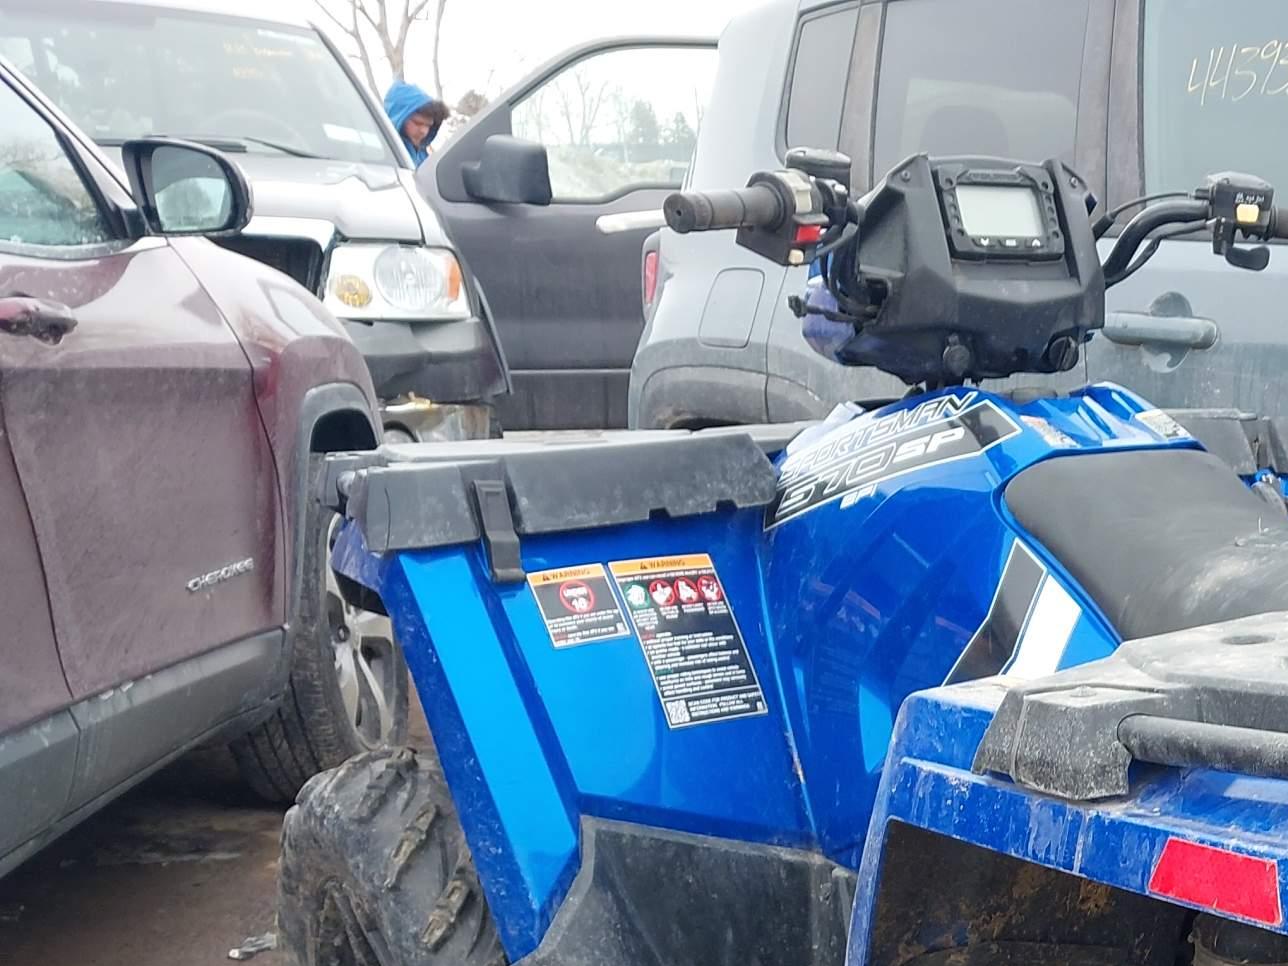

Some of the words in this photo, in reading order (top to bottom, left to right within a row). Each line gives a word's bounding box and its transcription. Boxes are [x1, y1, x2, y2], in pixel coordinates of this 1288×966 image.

[775, 442, 897, 520] 570
[892, 426, 966, 464] SP
[776, 391, 978, 489] SPORTSMAN
